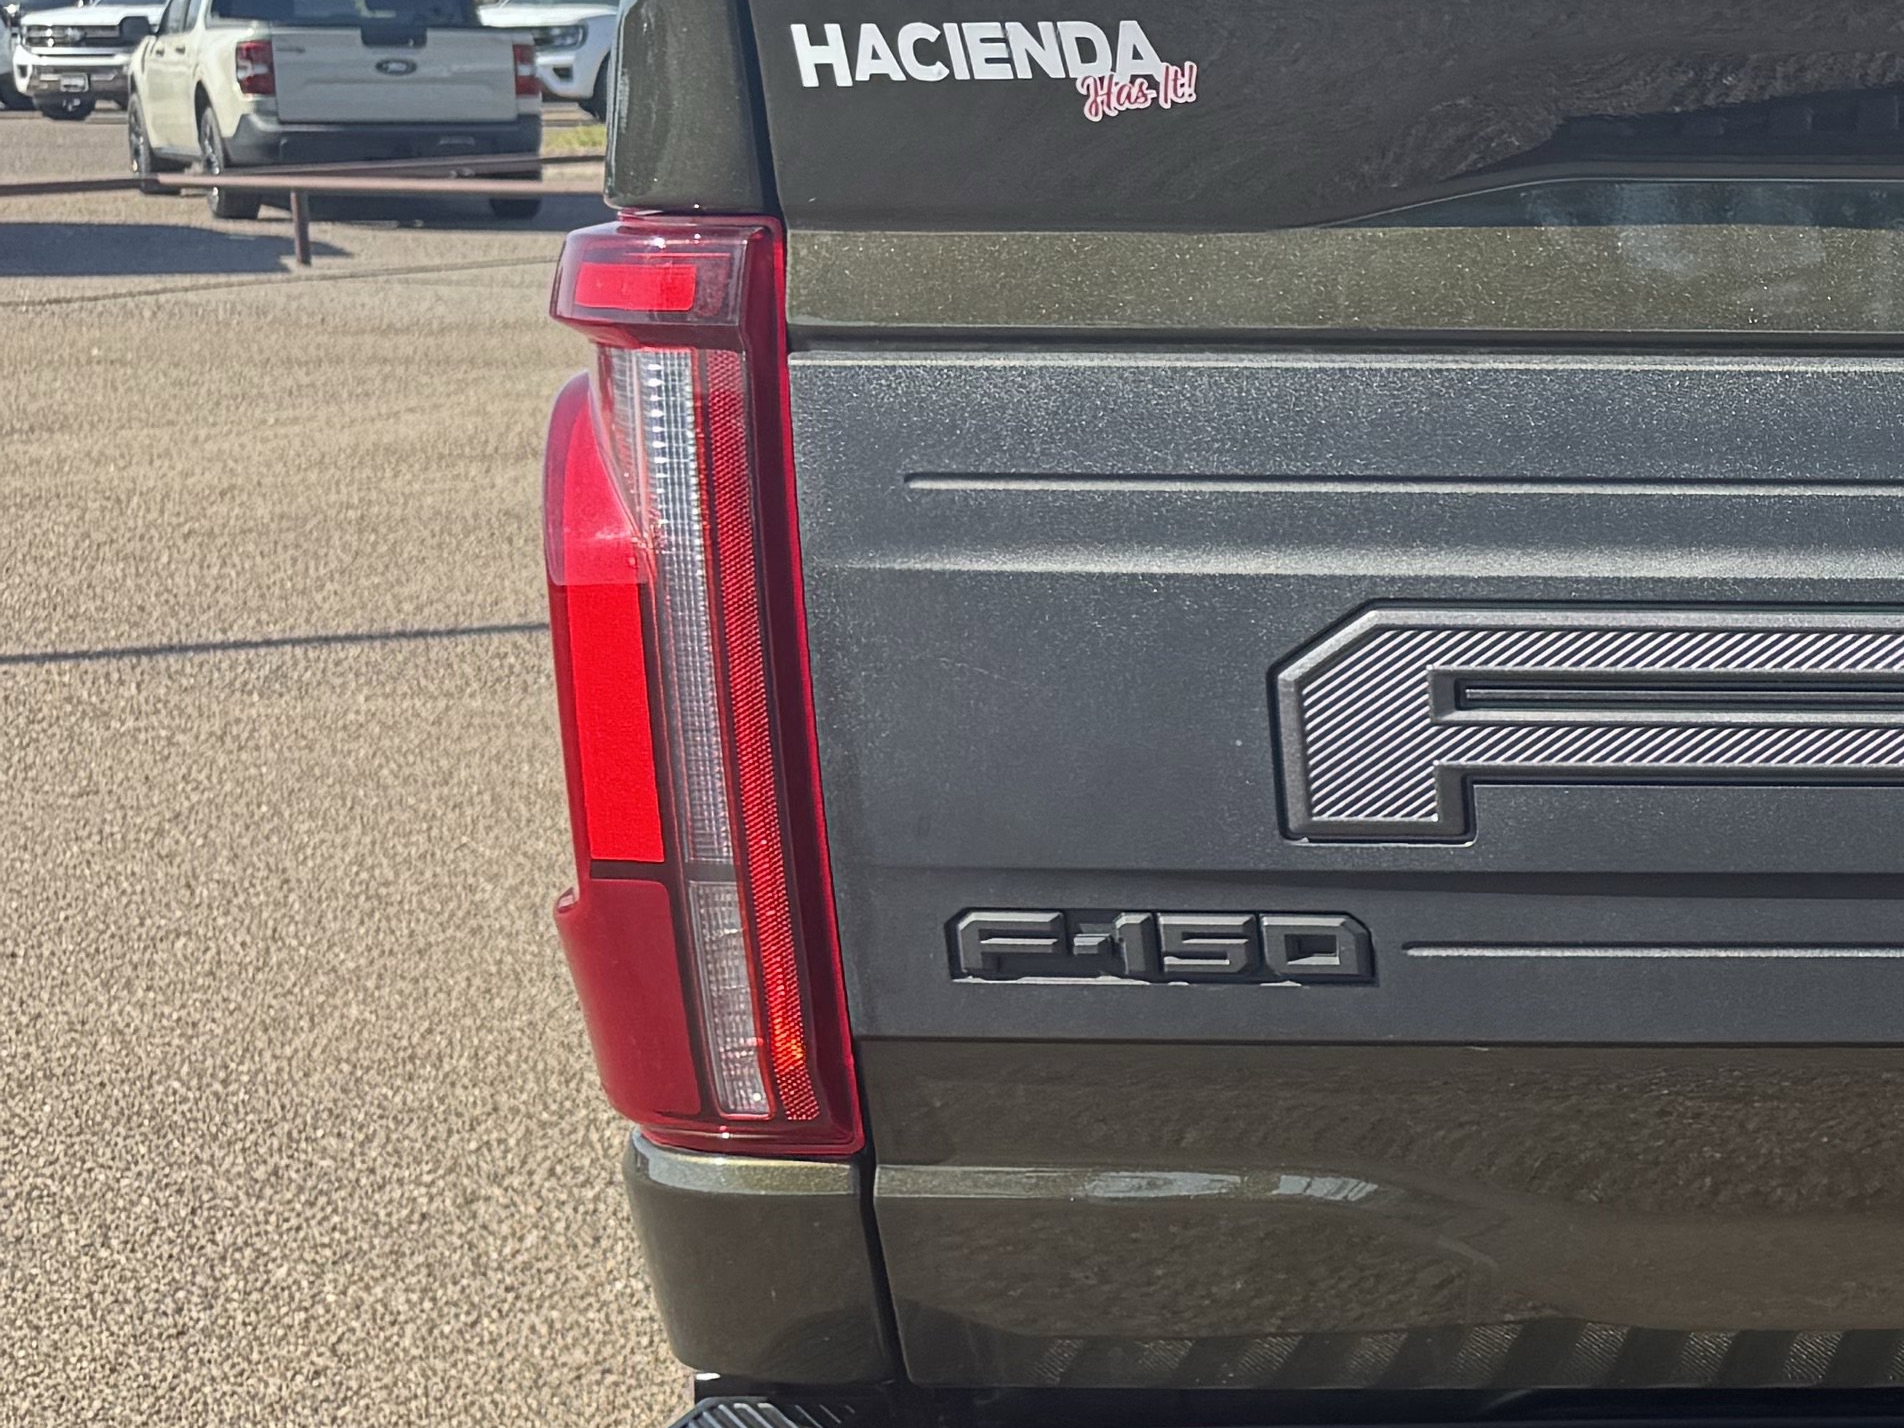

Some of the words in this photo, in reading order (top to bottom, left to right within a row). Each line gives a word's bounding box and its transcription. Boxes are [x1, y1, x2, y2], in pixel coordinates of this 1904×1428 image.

[790, 20, 1162, 87] HACIENDA
[1078, 72, 1154, 120] Has
[1160, 62, 1197, 108] It!
[946, 908, 1378, 985] F-150
